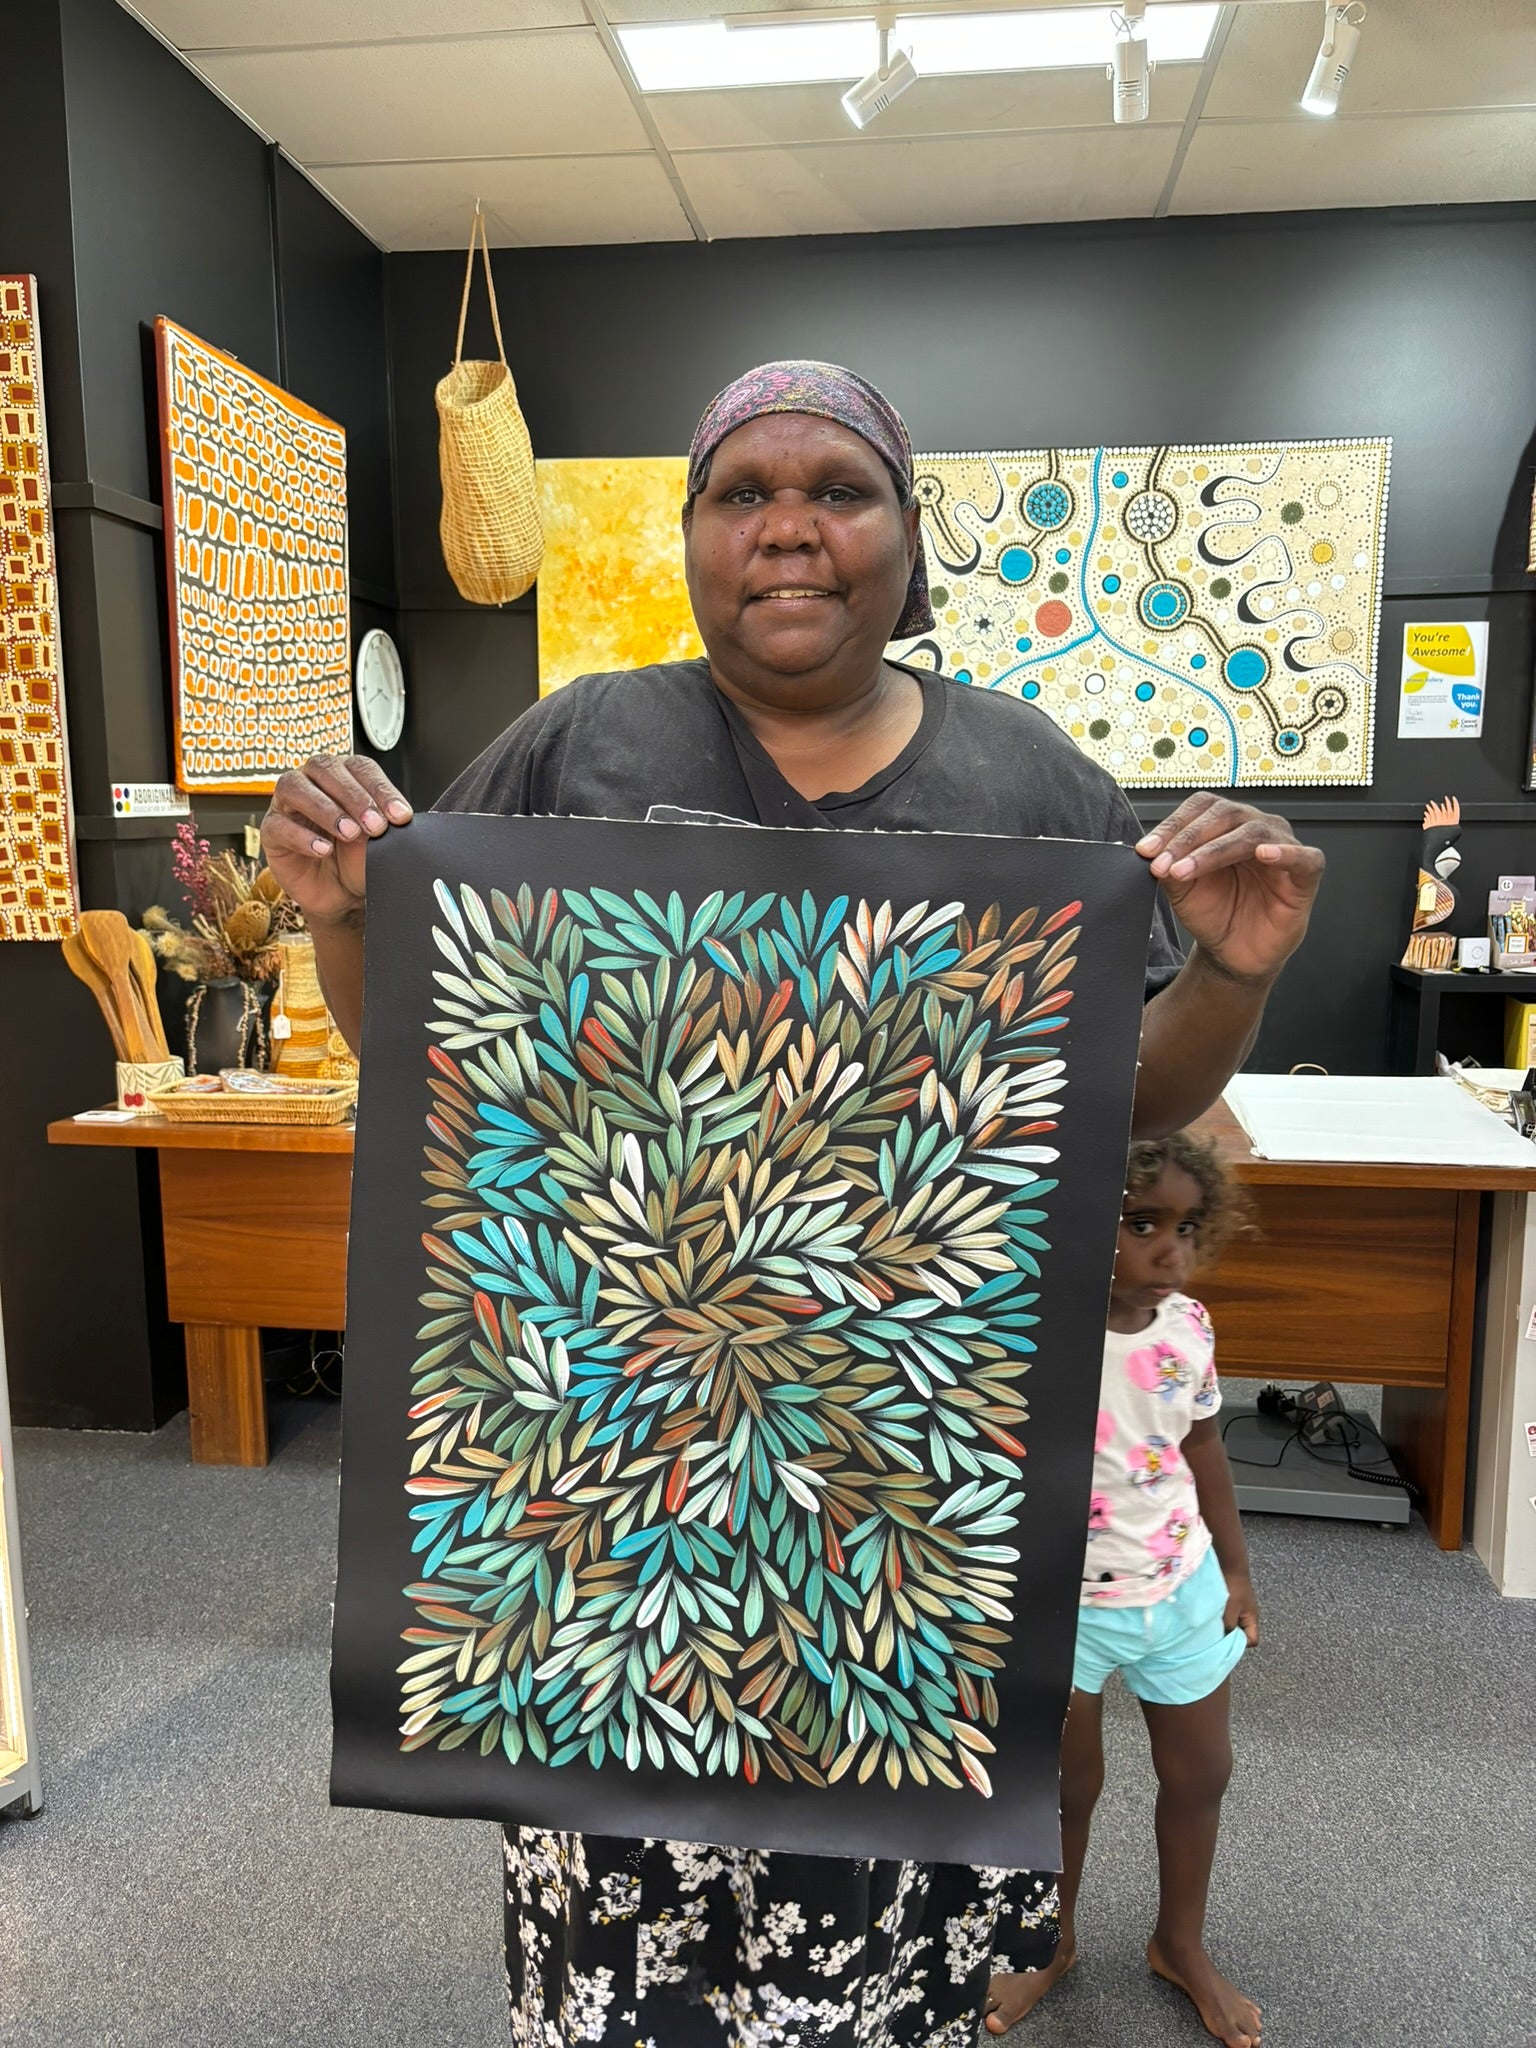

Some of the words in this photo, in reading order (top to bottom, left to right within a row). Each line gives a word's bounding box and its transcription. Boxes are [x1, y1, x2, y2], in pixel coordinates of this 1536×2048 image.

[1414, 632, 1450, 643] You're
[1412, 646, 1470, 656] Awesome!
[1457, 693, 1480, 701] Thank
[1461, 701, 1478, 709] you.
[134, 788, 174, 804] ABORIGINAL
